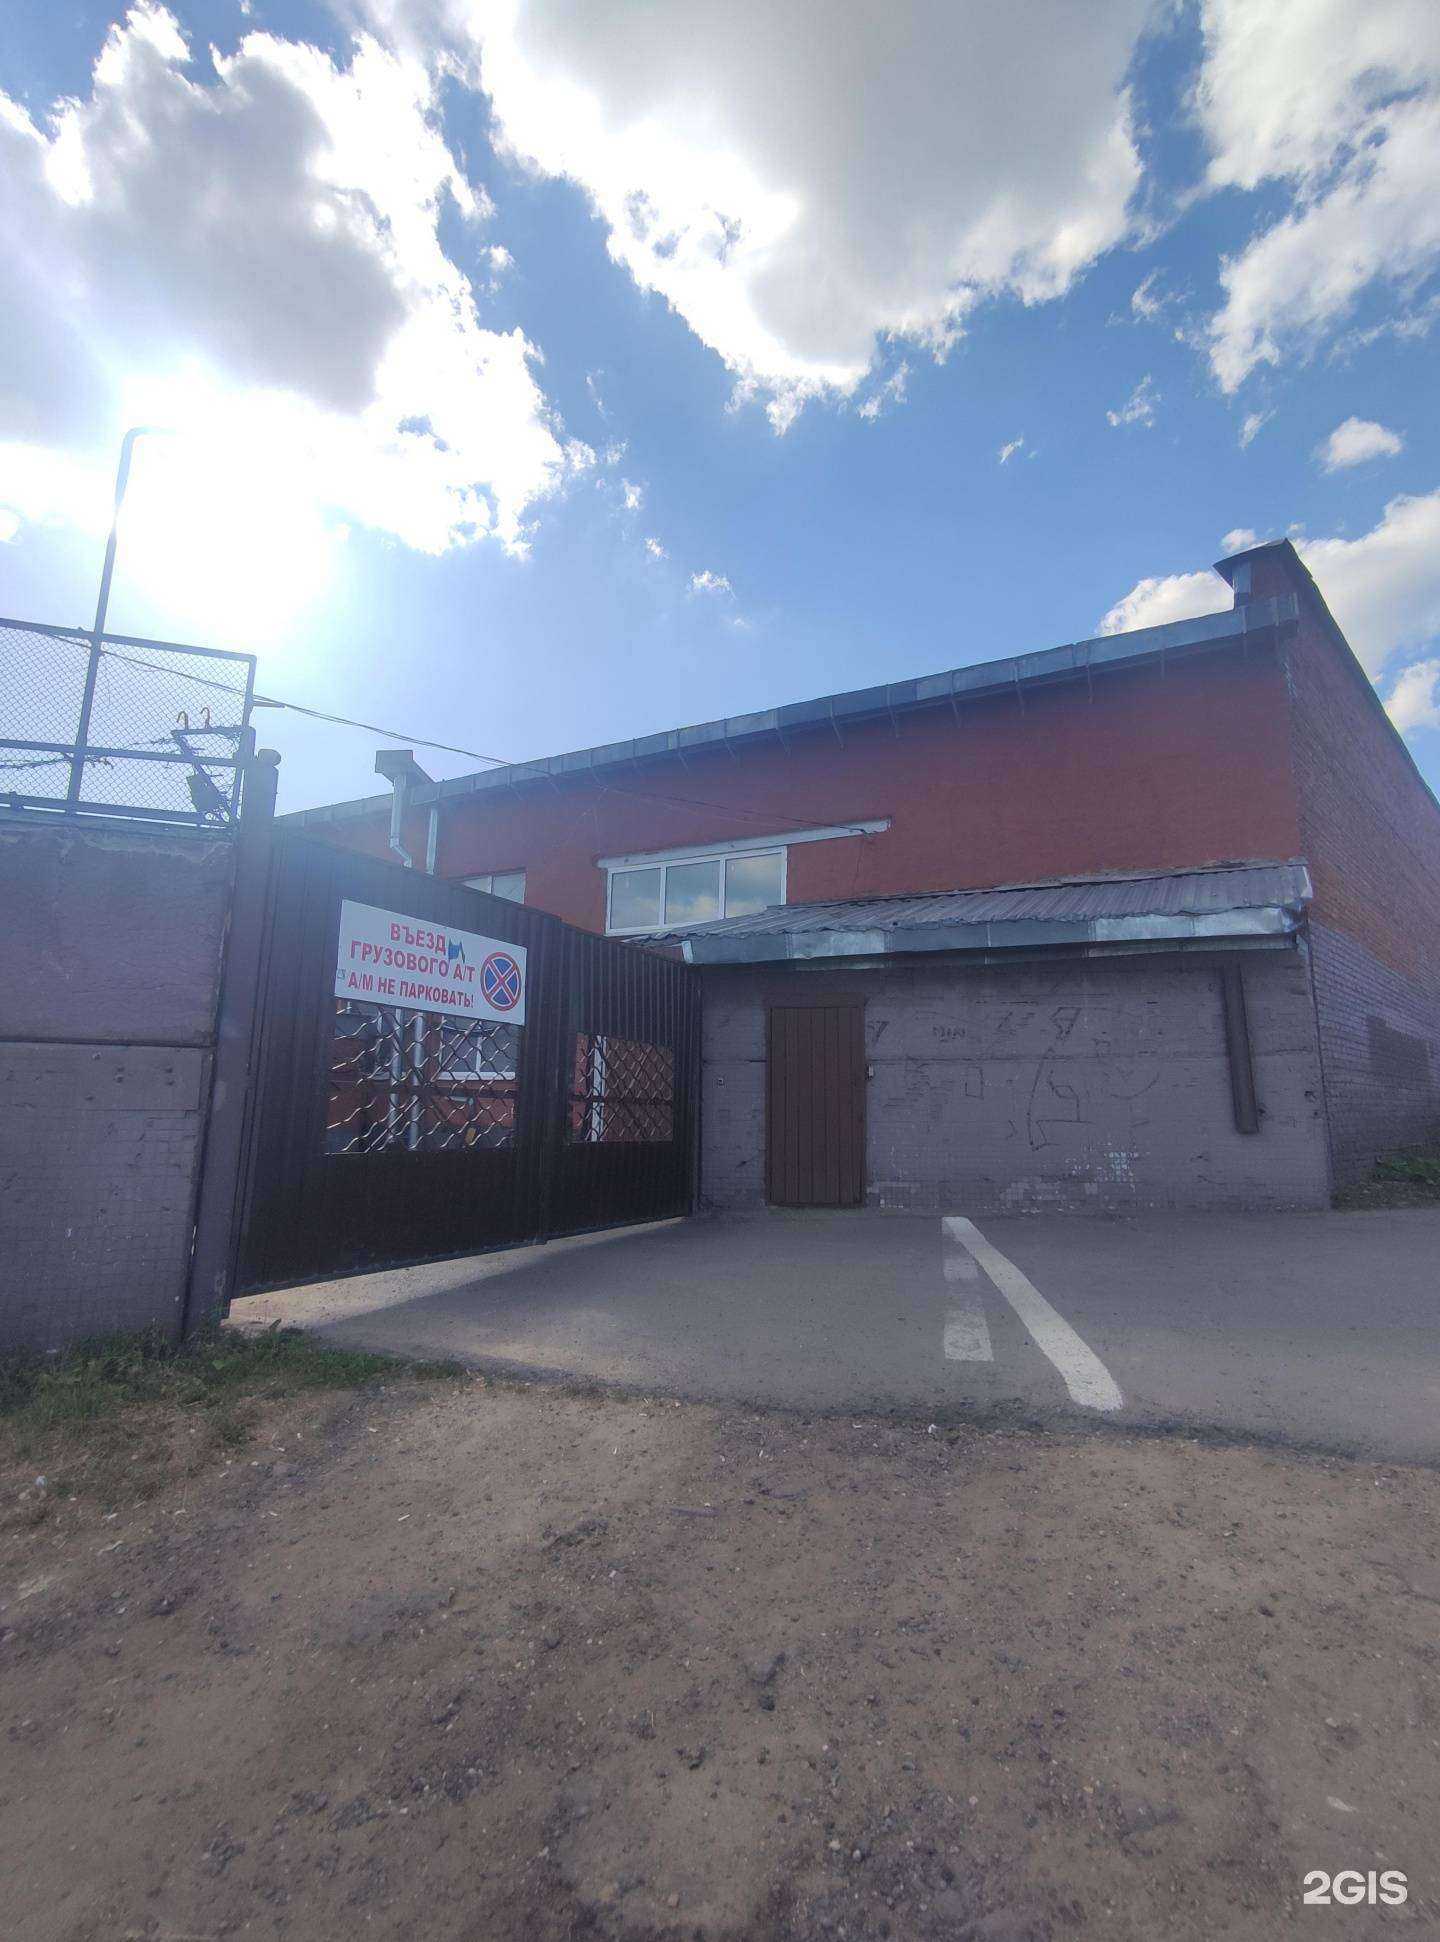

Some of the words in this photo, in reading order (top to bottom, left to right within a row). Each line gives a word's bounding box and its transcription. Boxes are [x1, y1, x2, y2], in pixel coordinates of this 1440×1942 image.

[390, 922, 447, 955] ВЪЕЗД
[350, 940, 449, 977] ГРУЗОВОГО
[453, 963, 475, 982] А/Т
[348, 971, 373, 991] А/М
[378, 976, 395, 995] НЕ
[400, 980, 474, 1008] ПАРКОВАТЬ!
